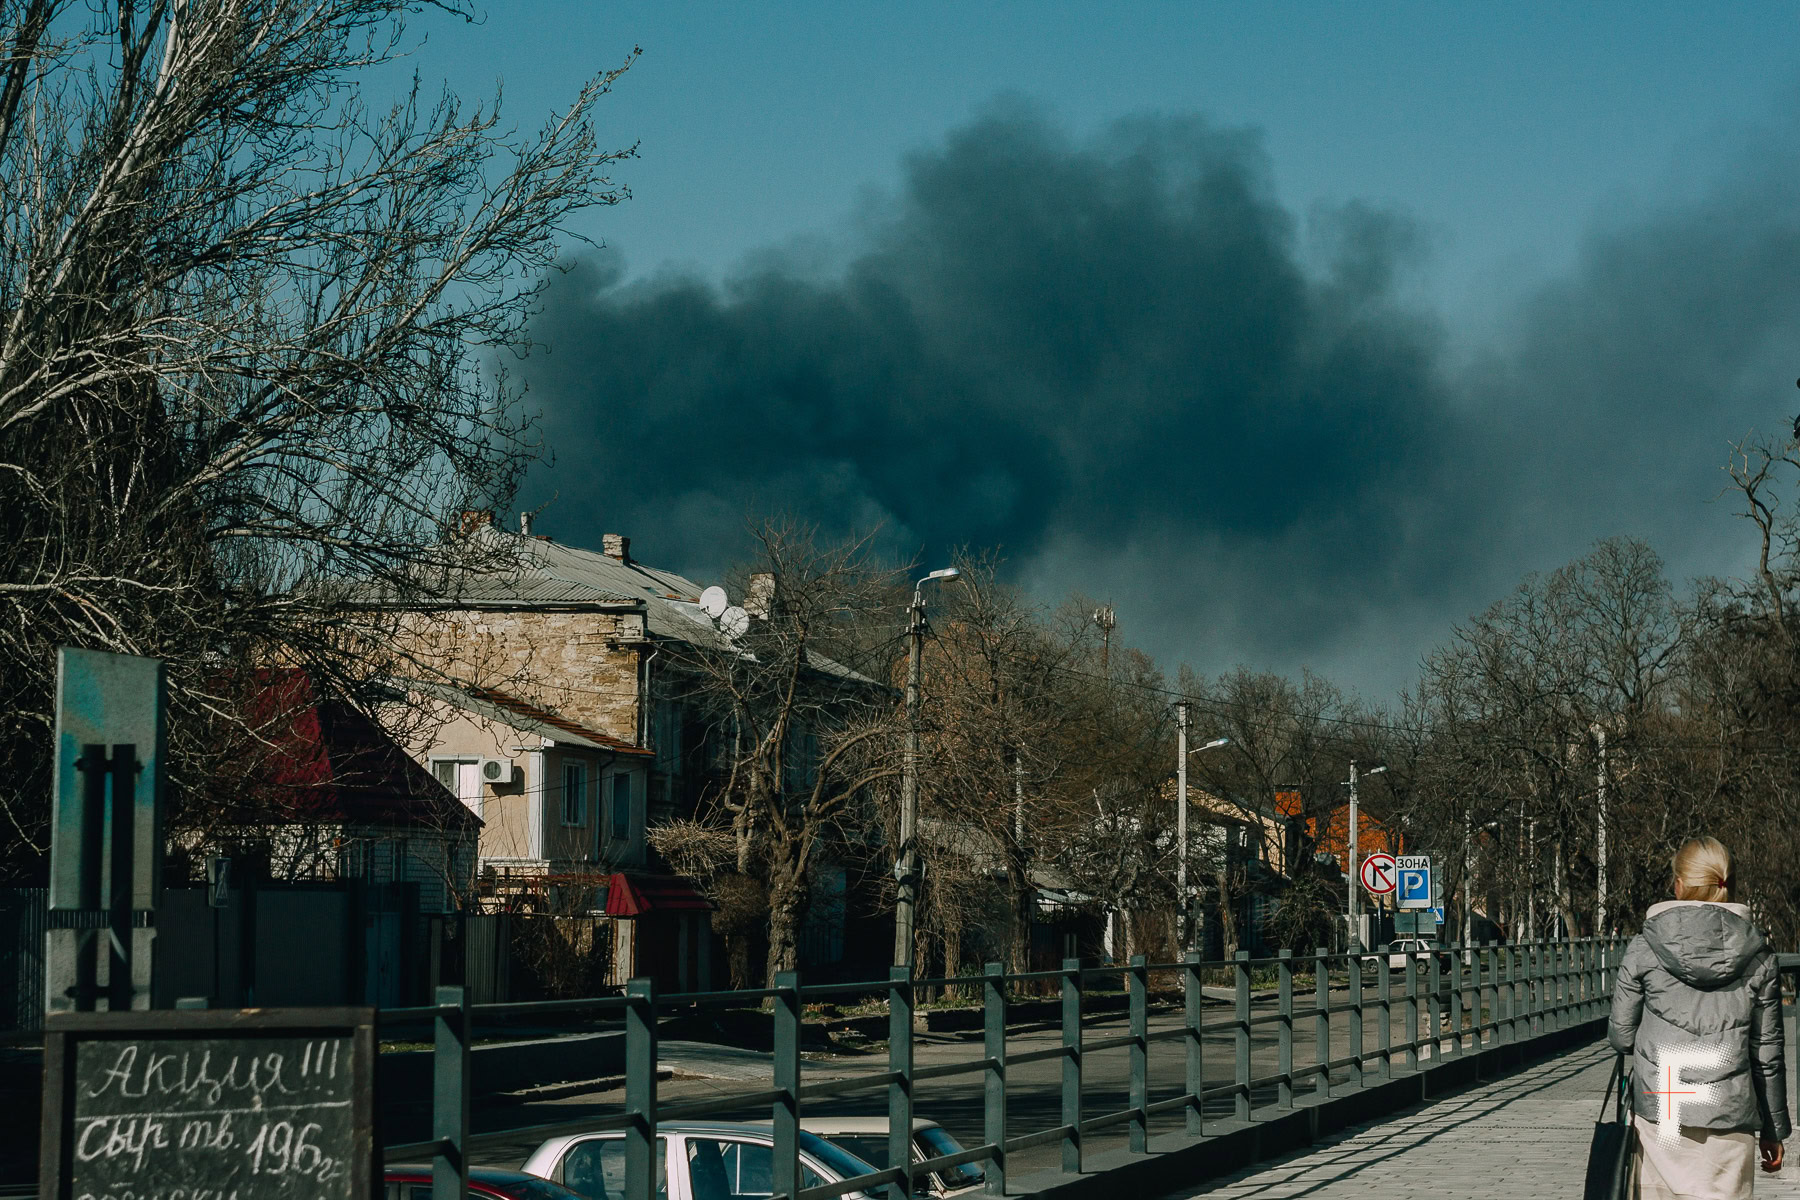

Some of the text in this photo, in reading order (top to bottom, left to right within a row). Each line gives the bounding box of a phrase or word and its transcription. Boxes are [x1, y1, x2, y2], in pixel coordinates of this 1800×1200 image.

[1397, 858, 1429, 869] ЗОНА
[1403, 872, 1424, 898] P
[77, 1115, 169, 1174] Сыр
